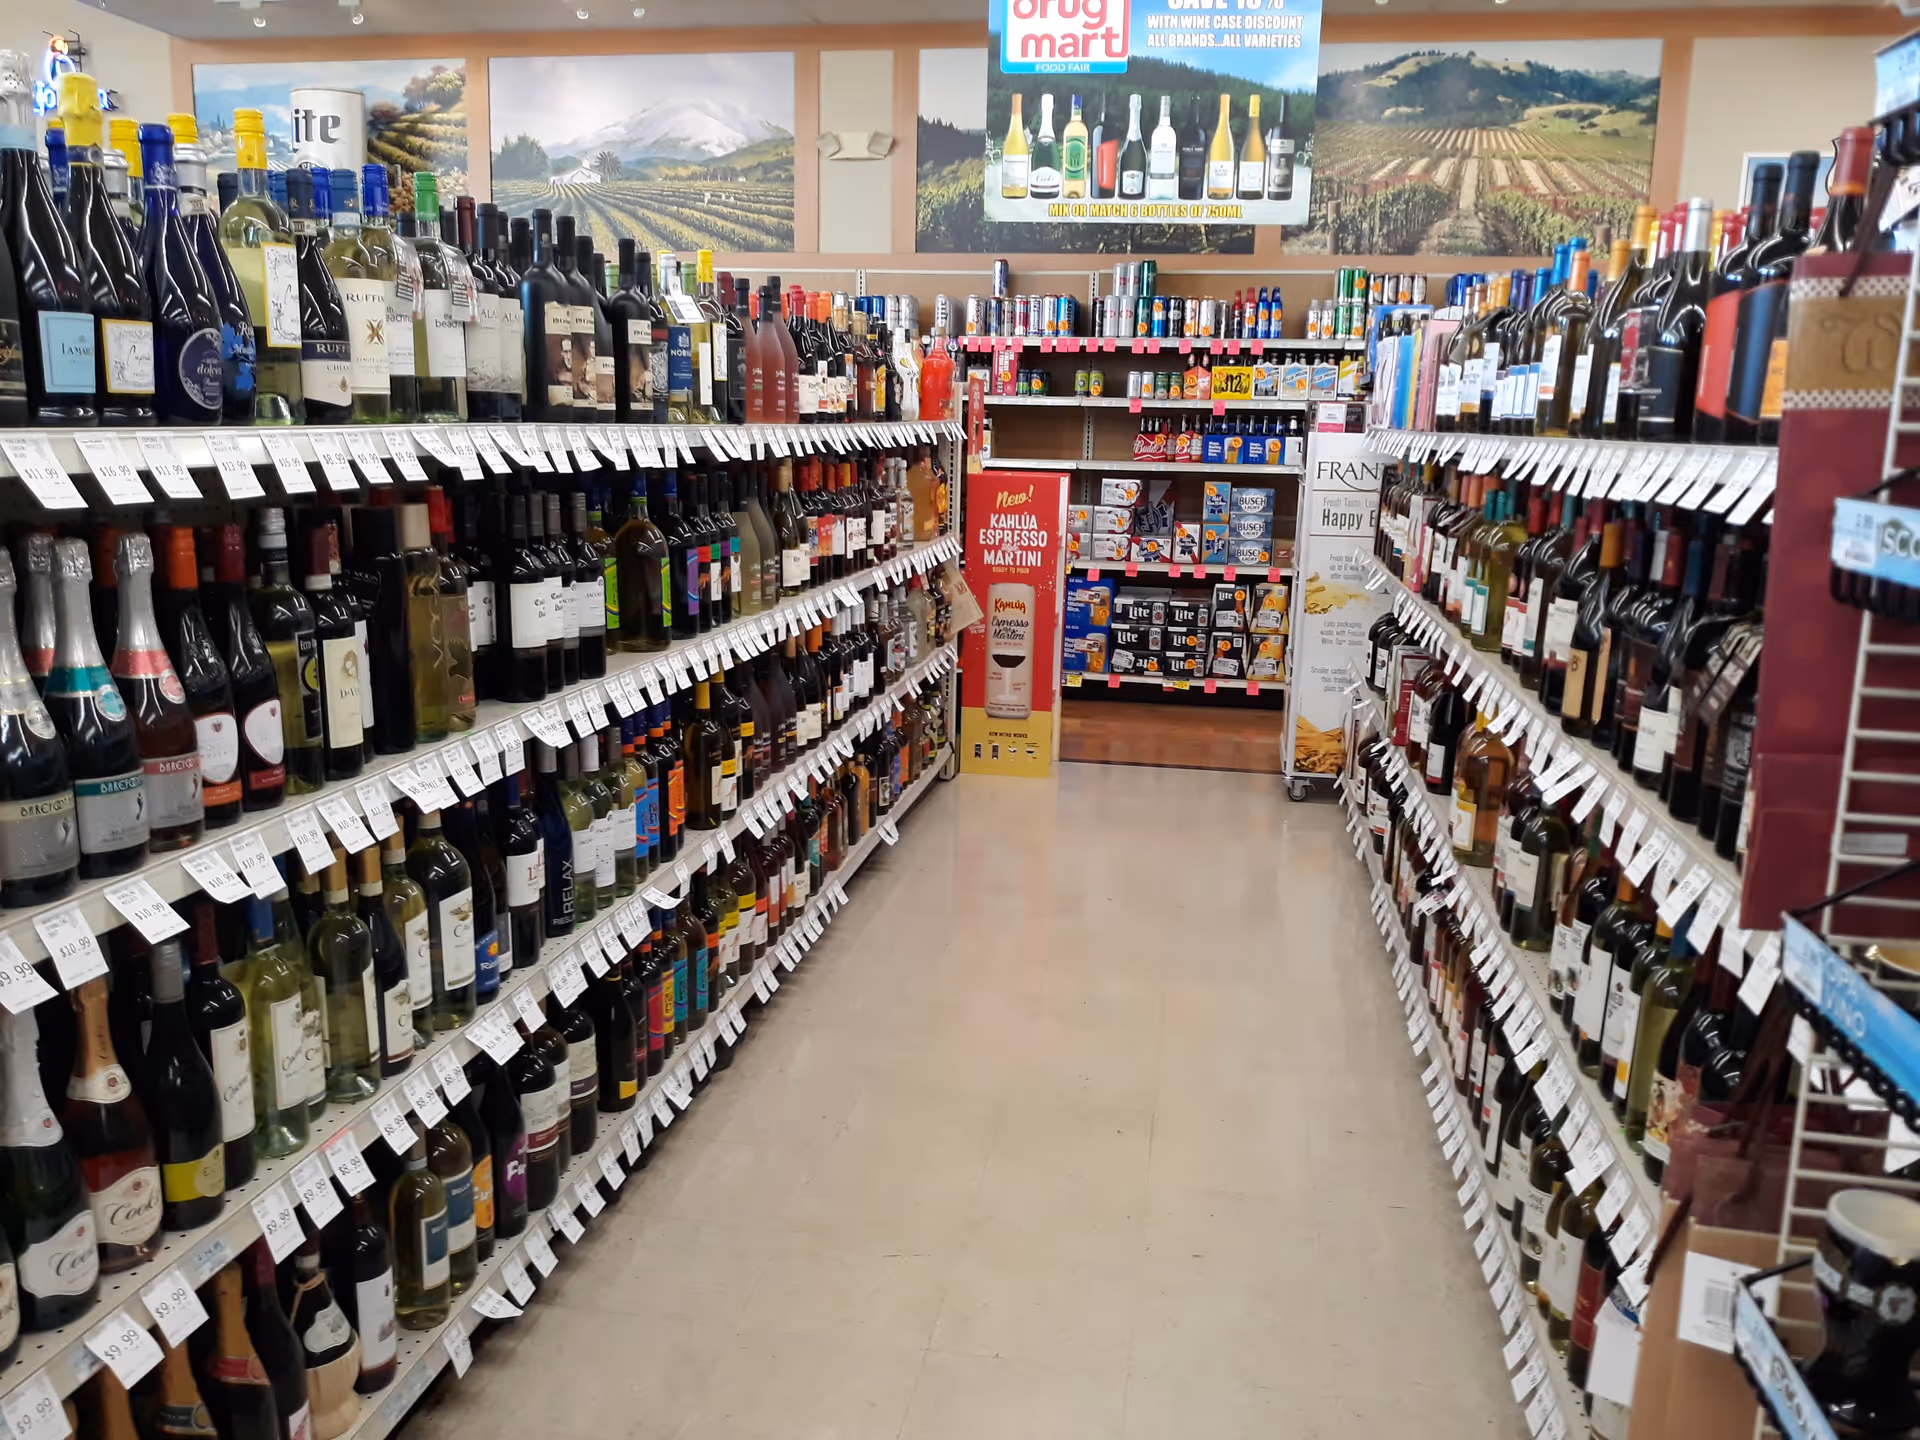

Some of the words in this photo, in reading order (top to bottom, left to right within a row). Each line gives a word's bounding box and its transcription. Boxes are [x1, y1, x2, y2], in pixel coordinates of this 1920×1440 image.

[1147, 15, 1178, 29] WITH
[1180, 15, 1211, 29] WINE
[1214, 15, 1242, 29] CASE
[1245, 15, 1304, 29] DISCOUNT
[1021, 27, 1129, 58] mart
[1147, 33, 1166, 47] ALL
[1244, 34, 1302, 48] VARIETIES
[1035, 63, 1066, 73] FOOD
[1067, 63, 1090, 73] FAIR
[291, 108, 341, 152] ite
[1049, 203, 1070, 217] MIX
[1072, 204, 1087, 217] OR
[1089, 204, 1129, 217] MATCH
[1131, 204, 1138, 217] 6
[1141, 204, 1187, 218] BOTTLES
[1190, 205, 1203, 218] OF
[1205, 204, 1243, 218] 750ML
[25, 468, 59, 480] $11.99
[100, 465, 131, 477] $16.99
[155, 465, 184, 476] $11.99
[997, 485, 1034, 509] New!
[1239, 497, 1267, 506] BUSCH
[990, 511, 1038, 530] KAHLÚA
[1237, 522, 1265, 532] BUSCH
[1322, 509, 1363, 530] Happy
[979, 529, 1048, 548] ESPRESSO
[984, 549, 1041, 567] MARTINI
[1218, 591, 1233, 600] Lite
[994, 598, 1026, 614] KAHLÚA
[1128, 606, 1150, 620] Lite
[1174, 609, 1195, 621] Lite
[1117, 630, 1138, 644] Lite
[337, 815, 358, 831] $10.99
[296, 829, 319, 846] $10.99
[242, 852, 266, 870] $10.99
[208, 871, 234, 889] $10.99
[562, 859, 574, 916] RELAX
[134, 902, 166, 921] $10.99
[59, 936, 91, 958] $10.99
[155, 1287, 187, 1319] $9.99
[104, 1329, 140, 1361] $9.99
[16, 1397, 52, 1434] $9.99
